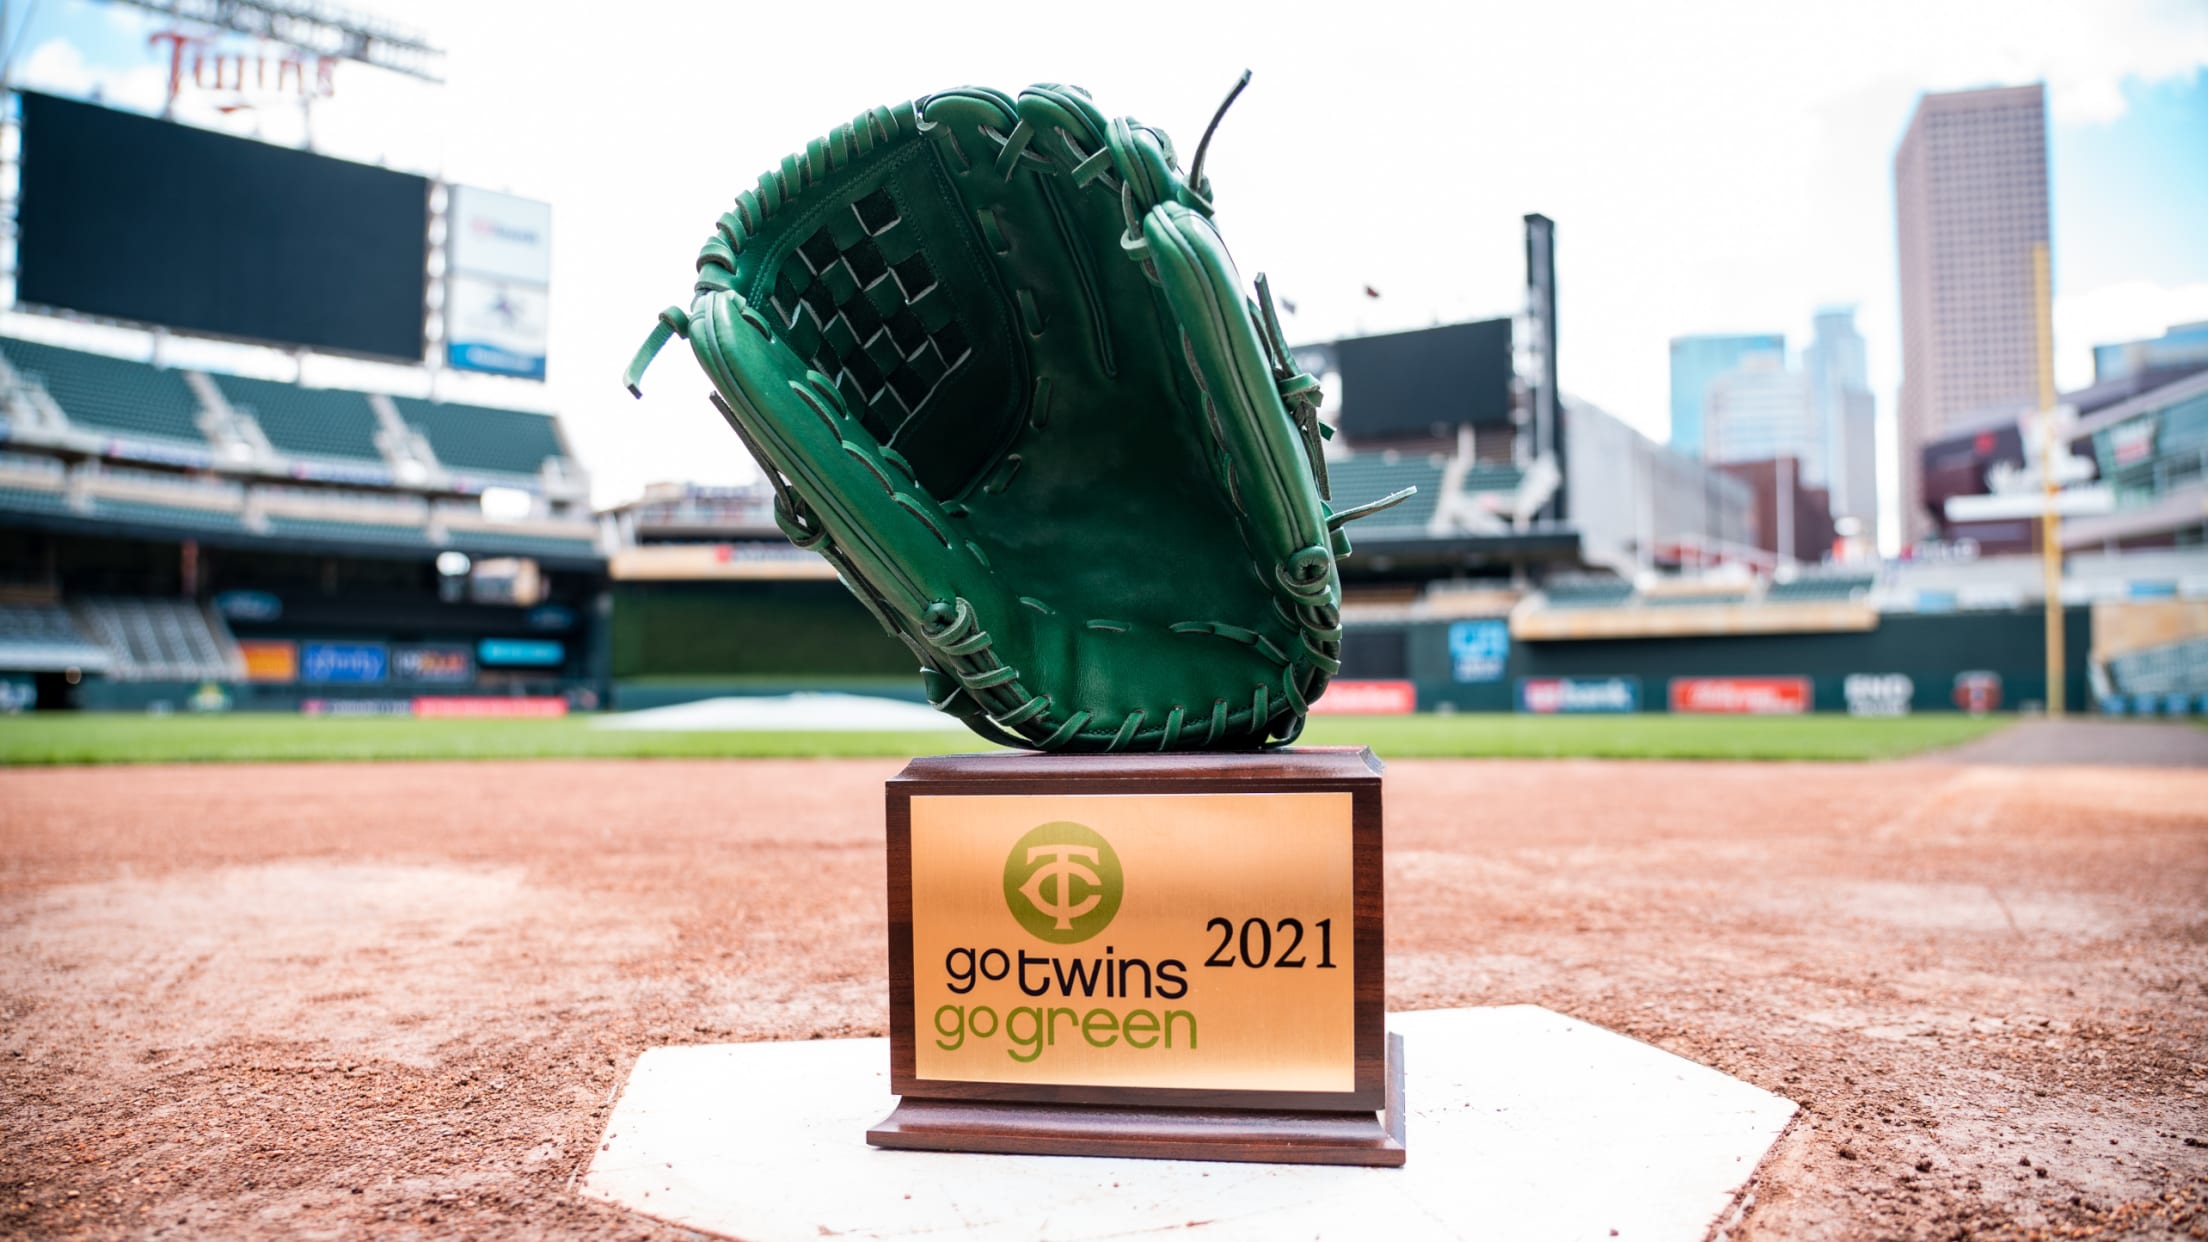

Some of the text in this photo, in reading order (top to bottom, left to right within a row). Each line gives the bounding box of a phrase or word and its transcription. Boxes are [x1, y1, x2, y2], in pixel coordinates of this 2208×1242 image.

[1203, 917, 1338, 970] 2021
[945, 946, 1189, 1000] go twins
[933, 1005, 1198, 1064] go green
